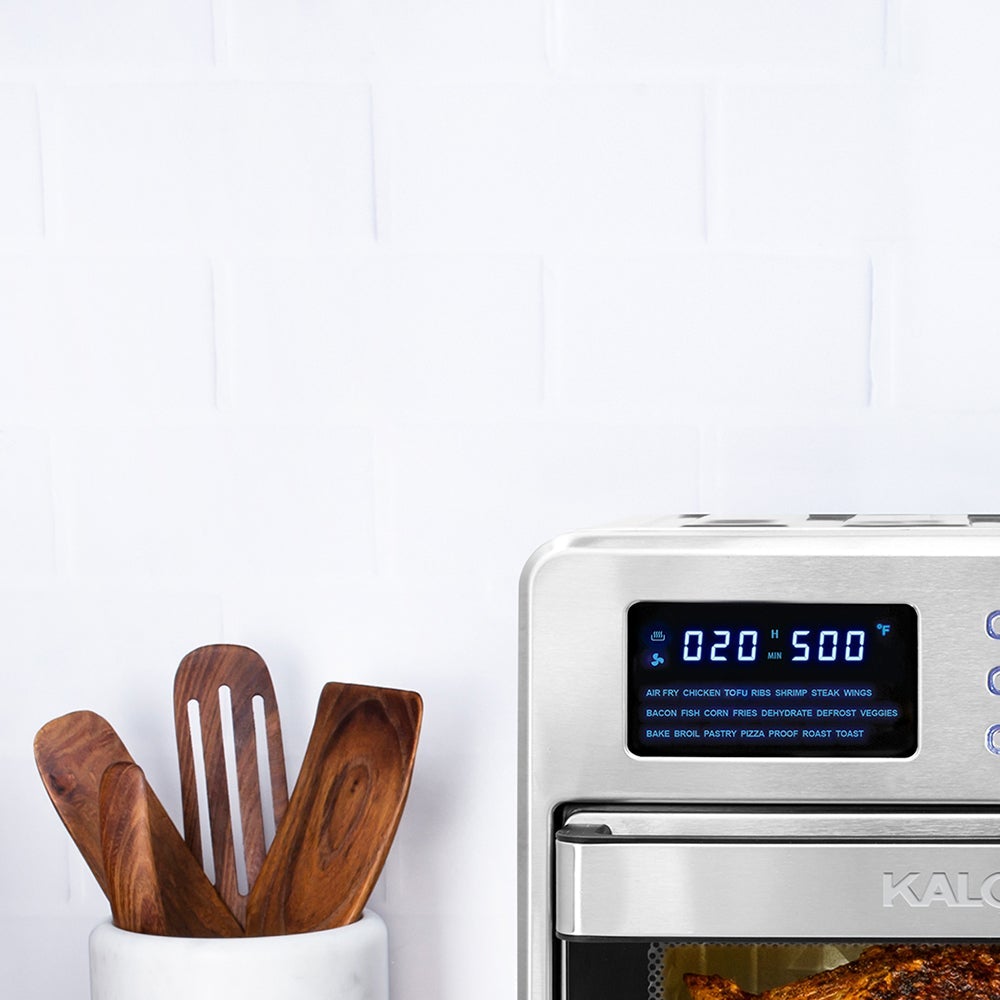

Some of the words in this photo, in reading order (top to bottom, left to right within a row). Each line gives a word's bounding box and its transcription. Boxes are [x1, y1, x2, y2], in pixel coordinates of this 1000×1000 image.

[771, 629, 779, 639] H
[683, 631, 758, 661] 020
[792, 631, 865, 661] 500
[768, 652, 782, 660] MIN
[646, 689, 661, 697] AIR
[663, 689, 679, 697] FRY
[683, 689, 721, 697] CHICKEN
[724, 689, 748, 697] TOFU
[752, 689, 771, 697] RIBS
[775, 689, 808, 697] SHRIMP
[811, 689, 840, 697] STEAK
[843, 689, 872, 697] WINGS
[646, 709, 677, 717] BACON
[681, 709, 700, 717] FISH
[704, 709, 729, 717] CORN
[733, 709, 757, 717] FRIES
[762, 709, 812, 717] DEHYDRATE
[817, 709, 856, 717] DEFROST
[860, 709, 898, 717] VEGGIES
[646, 729, 670, 738] BAKE
[674, 729, 700, 738] BROIL
[704, 729, 736, 738] PASTRY
[741, 729, 765, 738] PIZZA
[769, 729, 799, 738] PROOF
[803, 729, 832, 738] ROAST
[836, 729, 864, 738] TOAST
